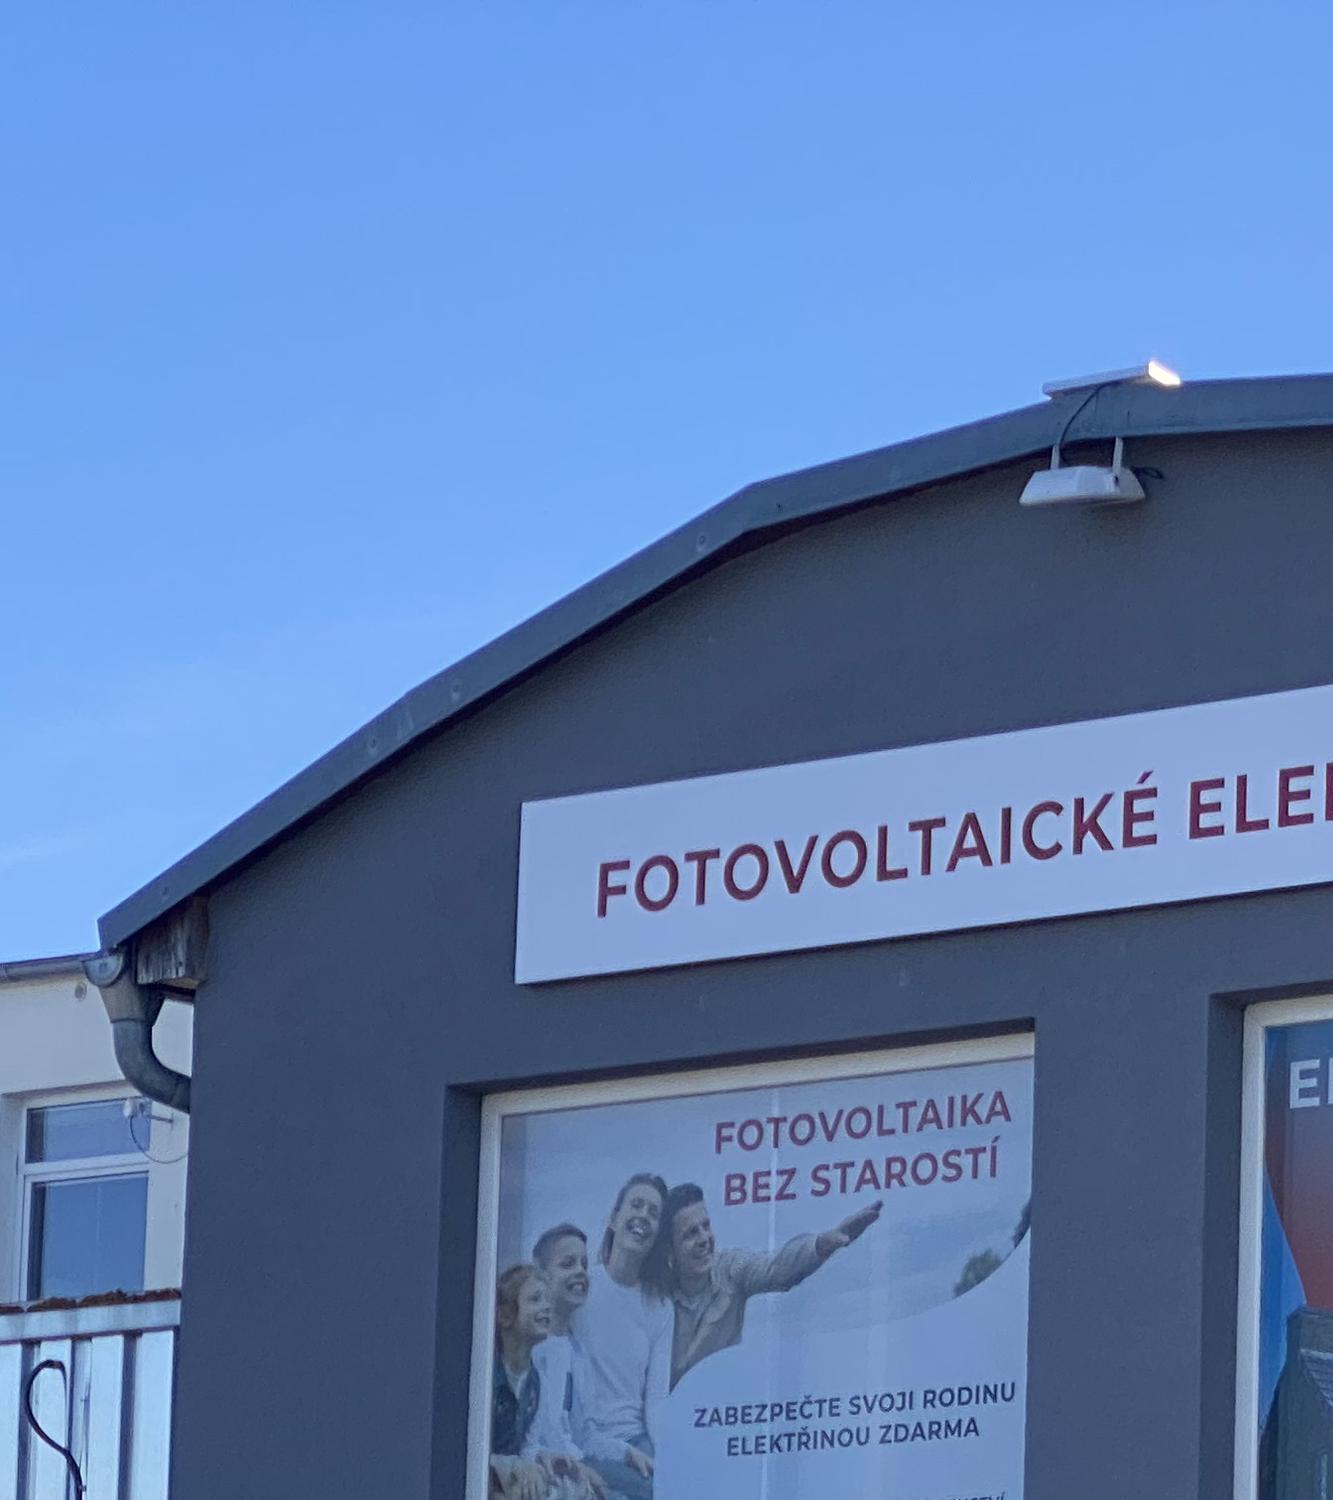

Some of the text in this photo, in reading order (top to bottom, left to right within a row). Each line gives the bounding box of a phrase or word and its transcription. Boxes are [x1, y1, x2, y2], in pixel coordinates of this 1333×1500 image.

[597, 770, 1158, 918] FOTOVOLTAICKÉ
[714, 1090, 1012, 1155] FOTOVOLTAIKA
[724, 1135, 1001, 1206] BEZ STAROSTÍ
[694, 1382, 1016, 1428] ZABEZPEČTE SVOJI RODINU
[726, 1417, 980, 1457] ELEKTŘINOU ZDARMA
